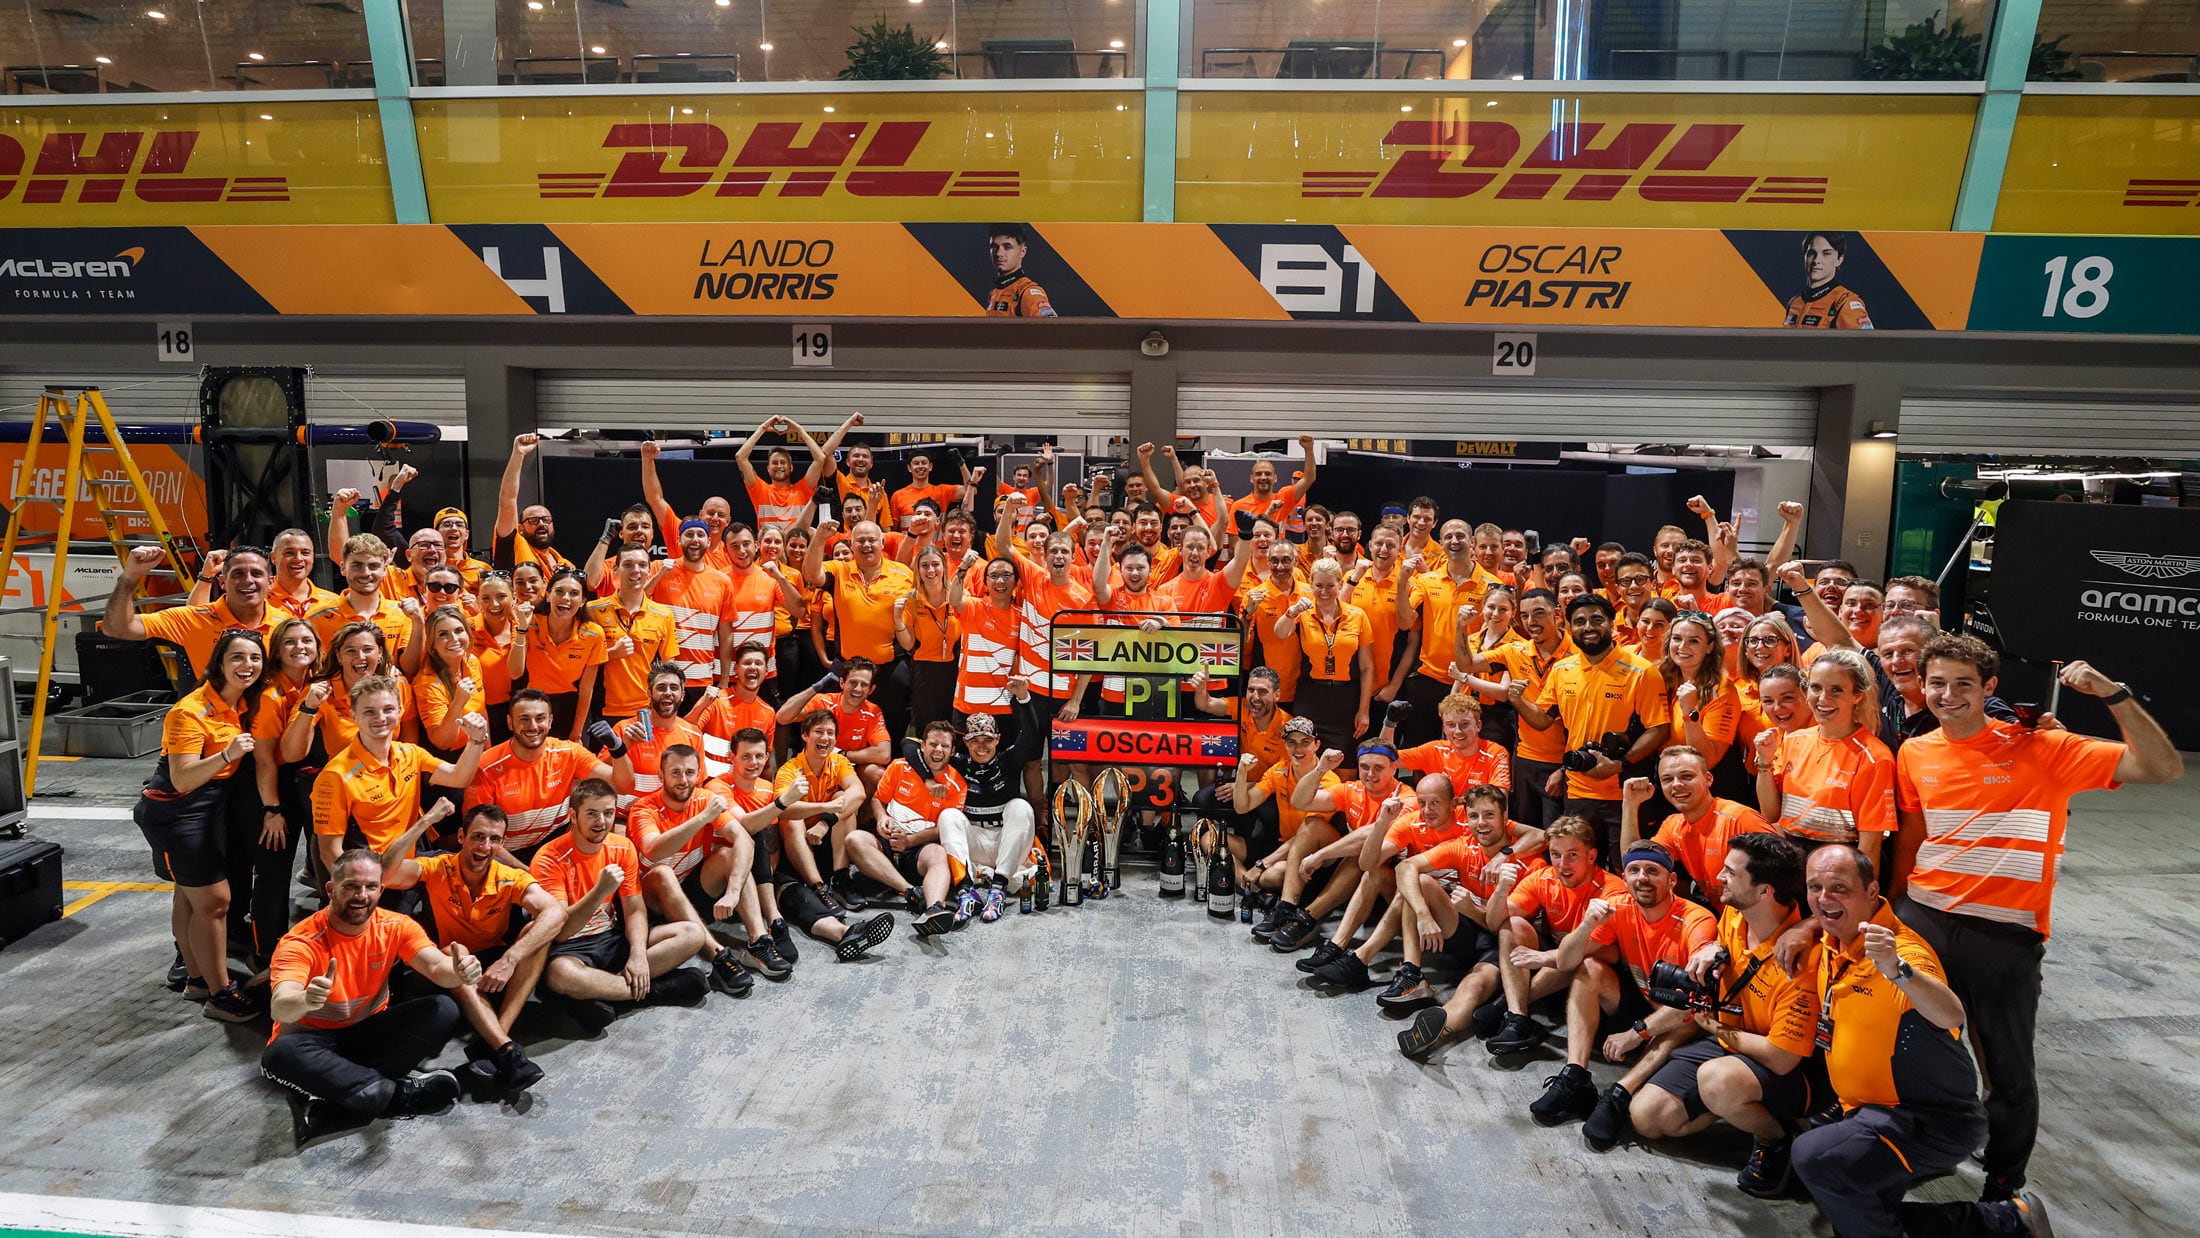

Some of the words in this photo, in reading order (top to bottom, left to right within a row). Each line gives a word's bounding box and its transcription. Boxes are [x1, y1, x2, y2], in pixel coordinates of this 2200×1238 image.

[0, 131, 228, 203] HL
[601, 122, 953, 198] DHL
[1369, 121, 1758, 203] DHL
[700, 239, 834, 267] LANDO
[1479, 245, 1622, 274] OSCAR
[0, 259, 130, 277] McLaren
[1260, 244, 1375, 313] 81
[15, 289, 79, 299] FORMULA
[86, 290, 92, 299] 1
[100, 290, 135, 299] TEAM
[693, 273, 838, 300] NORRIS
[1464, 280, 1633, 309] PIASTRI
[2043, 256, 2114, 318] 18
[161, 331, 190, 355] 18
[795, 333, 829, 359] 19
[1496, 341, 1534, 368] 20
[2154, 559, 2185, 567] MARTIN
[2080, 589, 2200, 615] aramc
[2077, 611, 2140, 625] FORMULA
[1093, 641, 1198, 664] LANDO
[1125, 677, 1176, 718] P1
[1096, 731, 1193, 756] OSCAR
[1121, 767, 1175, 807] P3
[1921, 775, 1939, 783] DELL
[1984, 775, 2011, 784] OKX
